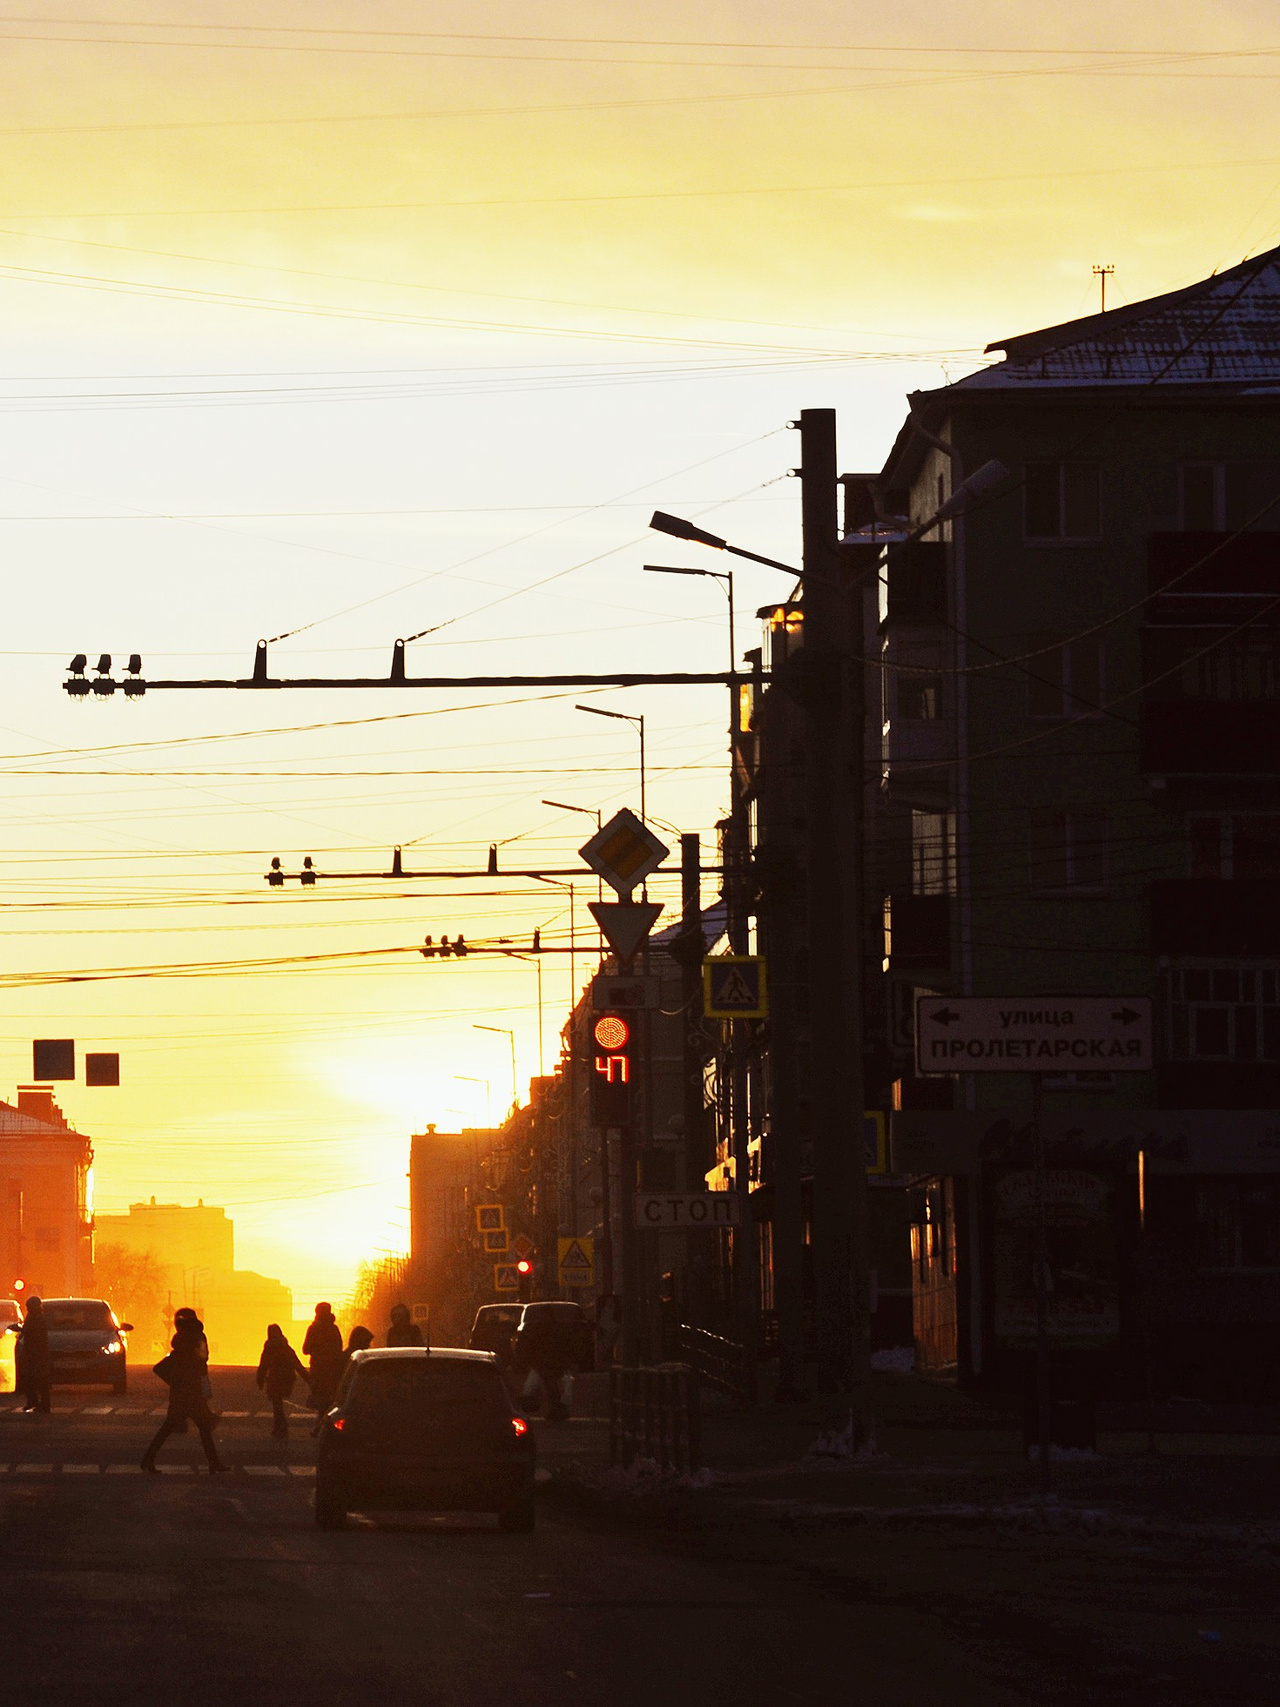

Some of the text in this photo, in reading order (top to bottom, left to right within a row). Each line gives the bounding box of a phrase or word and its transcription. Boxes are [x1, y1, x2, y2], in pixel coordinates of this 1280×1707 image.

[999, 1010, 1074, 1029] улица
[930, 1039, 1141, 1058] ПРОЛЕТАРСКАЯ
[594, 1055, 628, 1084] 47
[645, 1199, 732, 1222] СТОП
